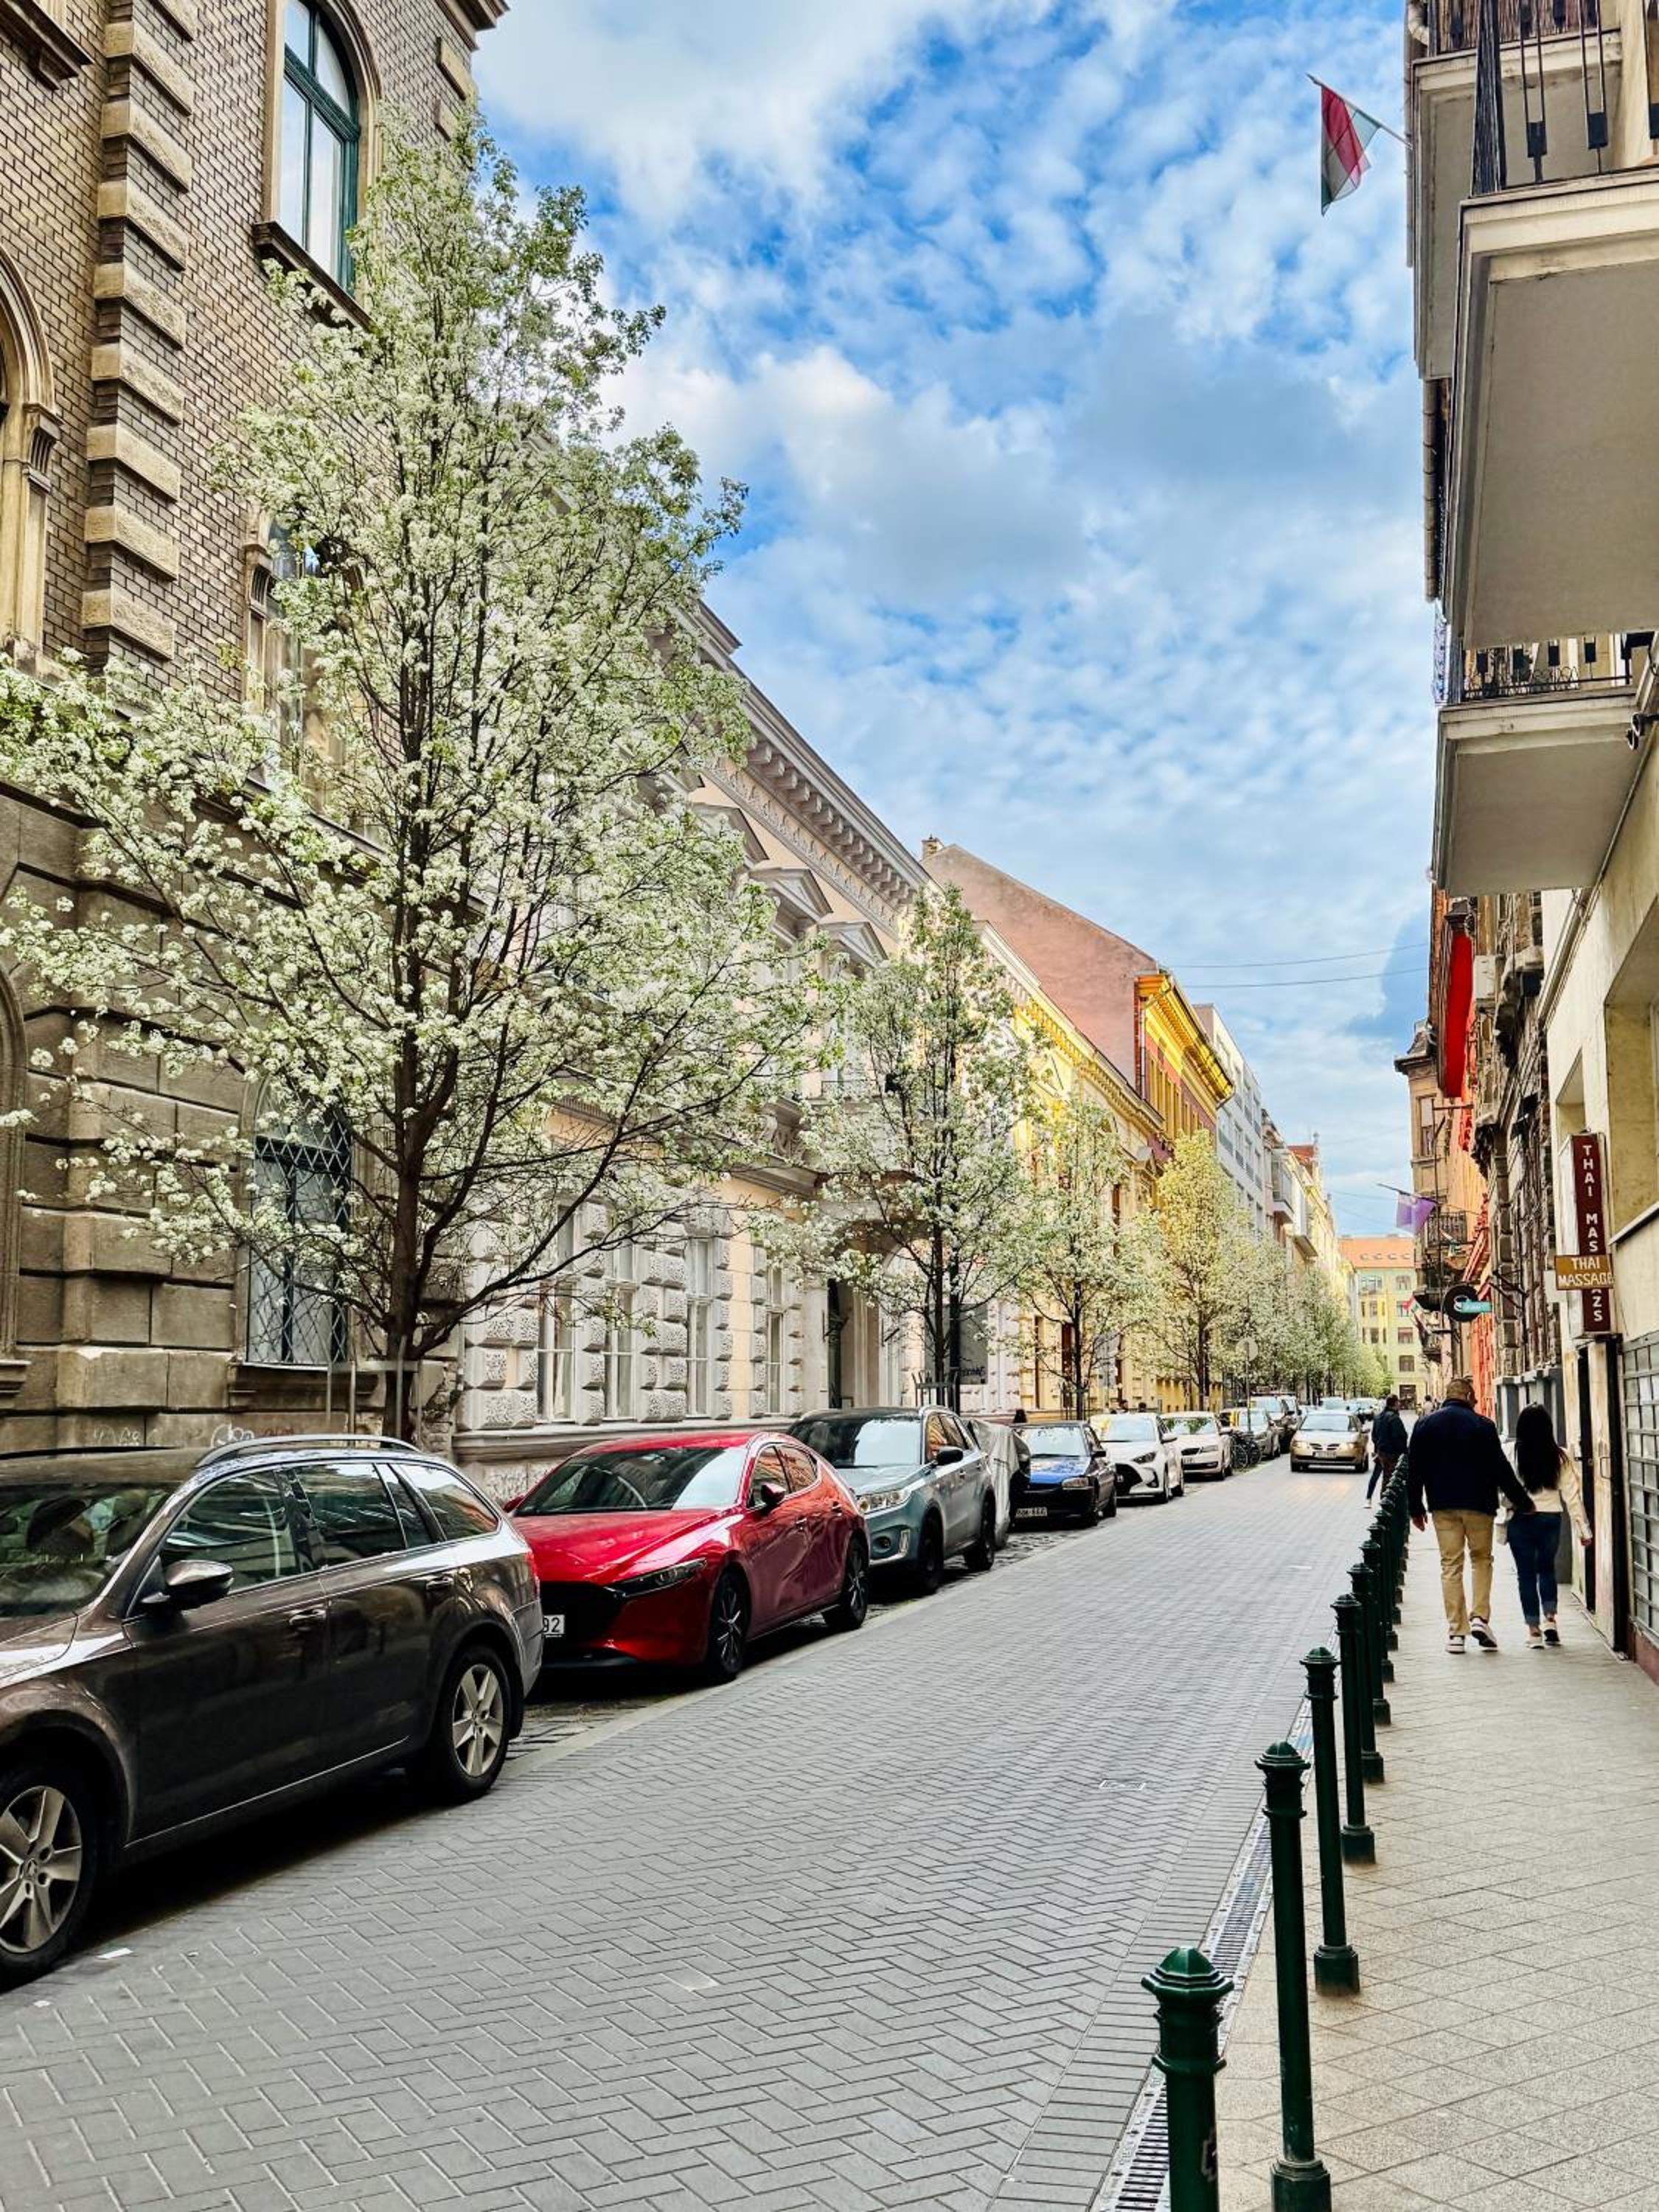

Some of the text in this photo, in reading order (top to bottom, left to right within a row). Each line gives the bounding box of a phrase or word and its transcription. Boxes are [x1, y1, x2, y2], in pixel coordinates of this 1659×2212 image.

[1582, 1145, 1595, 1197] THAI
[1571, 1257, 1601, 1270] THAI
[1558, 1272, 1614, 1286] MASSAGE
